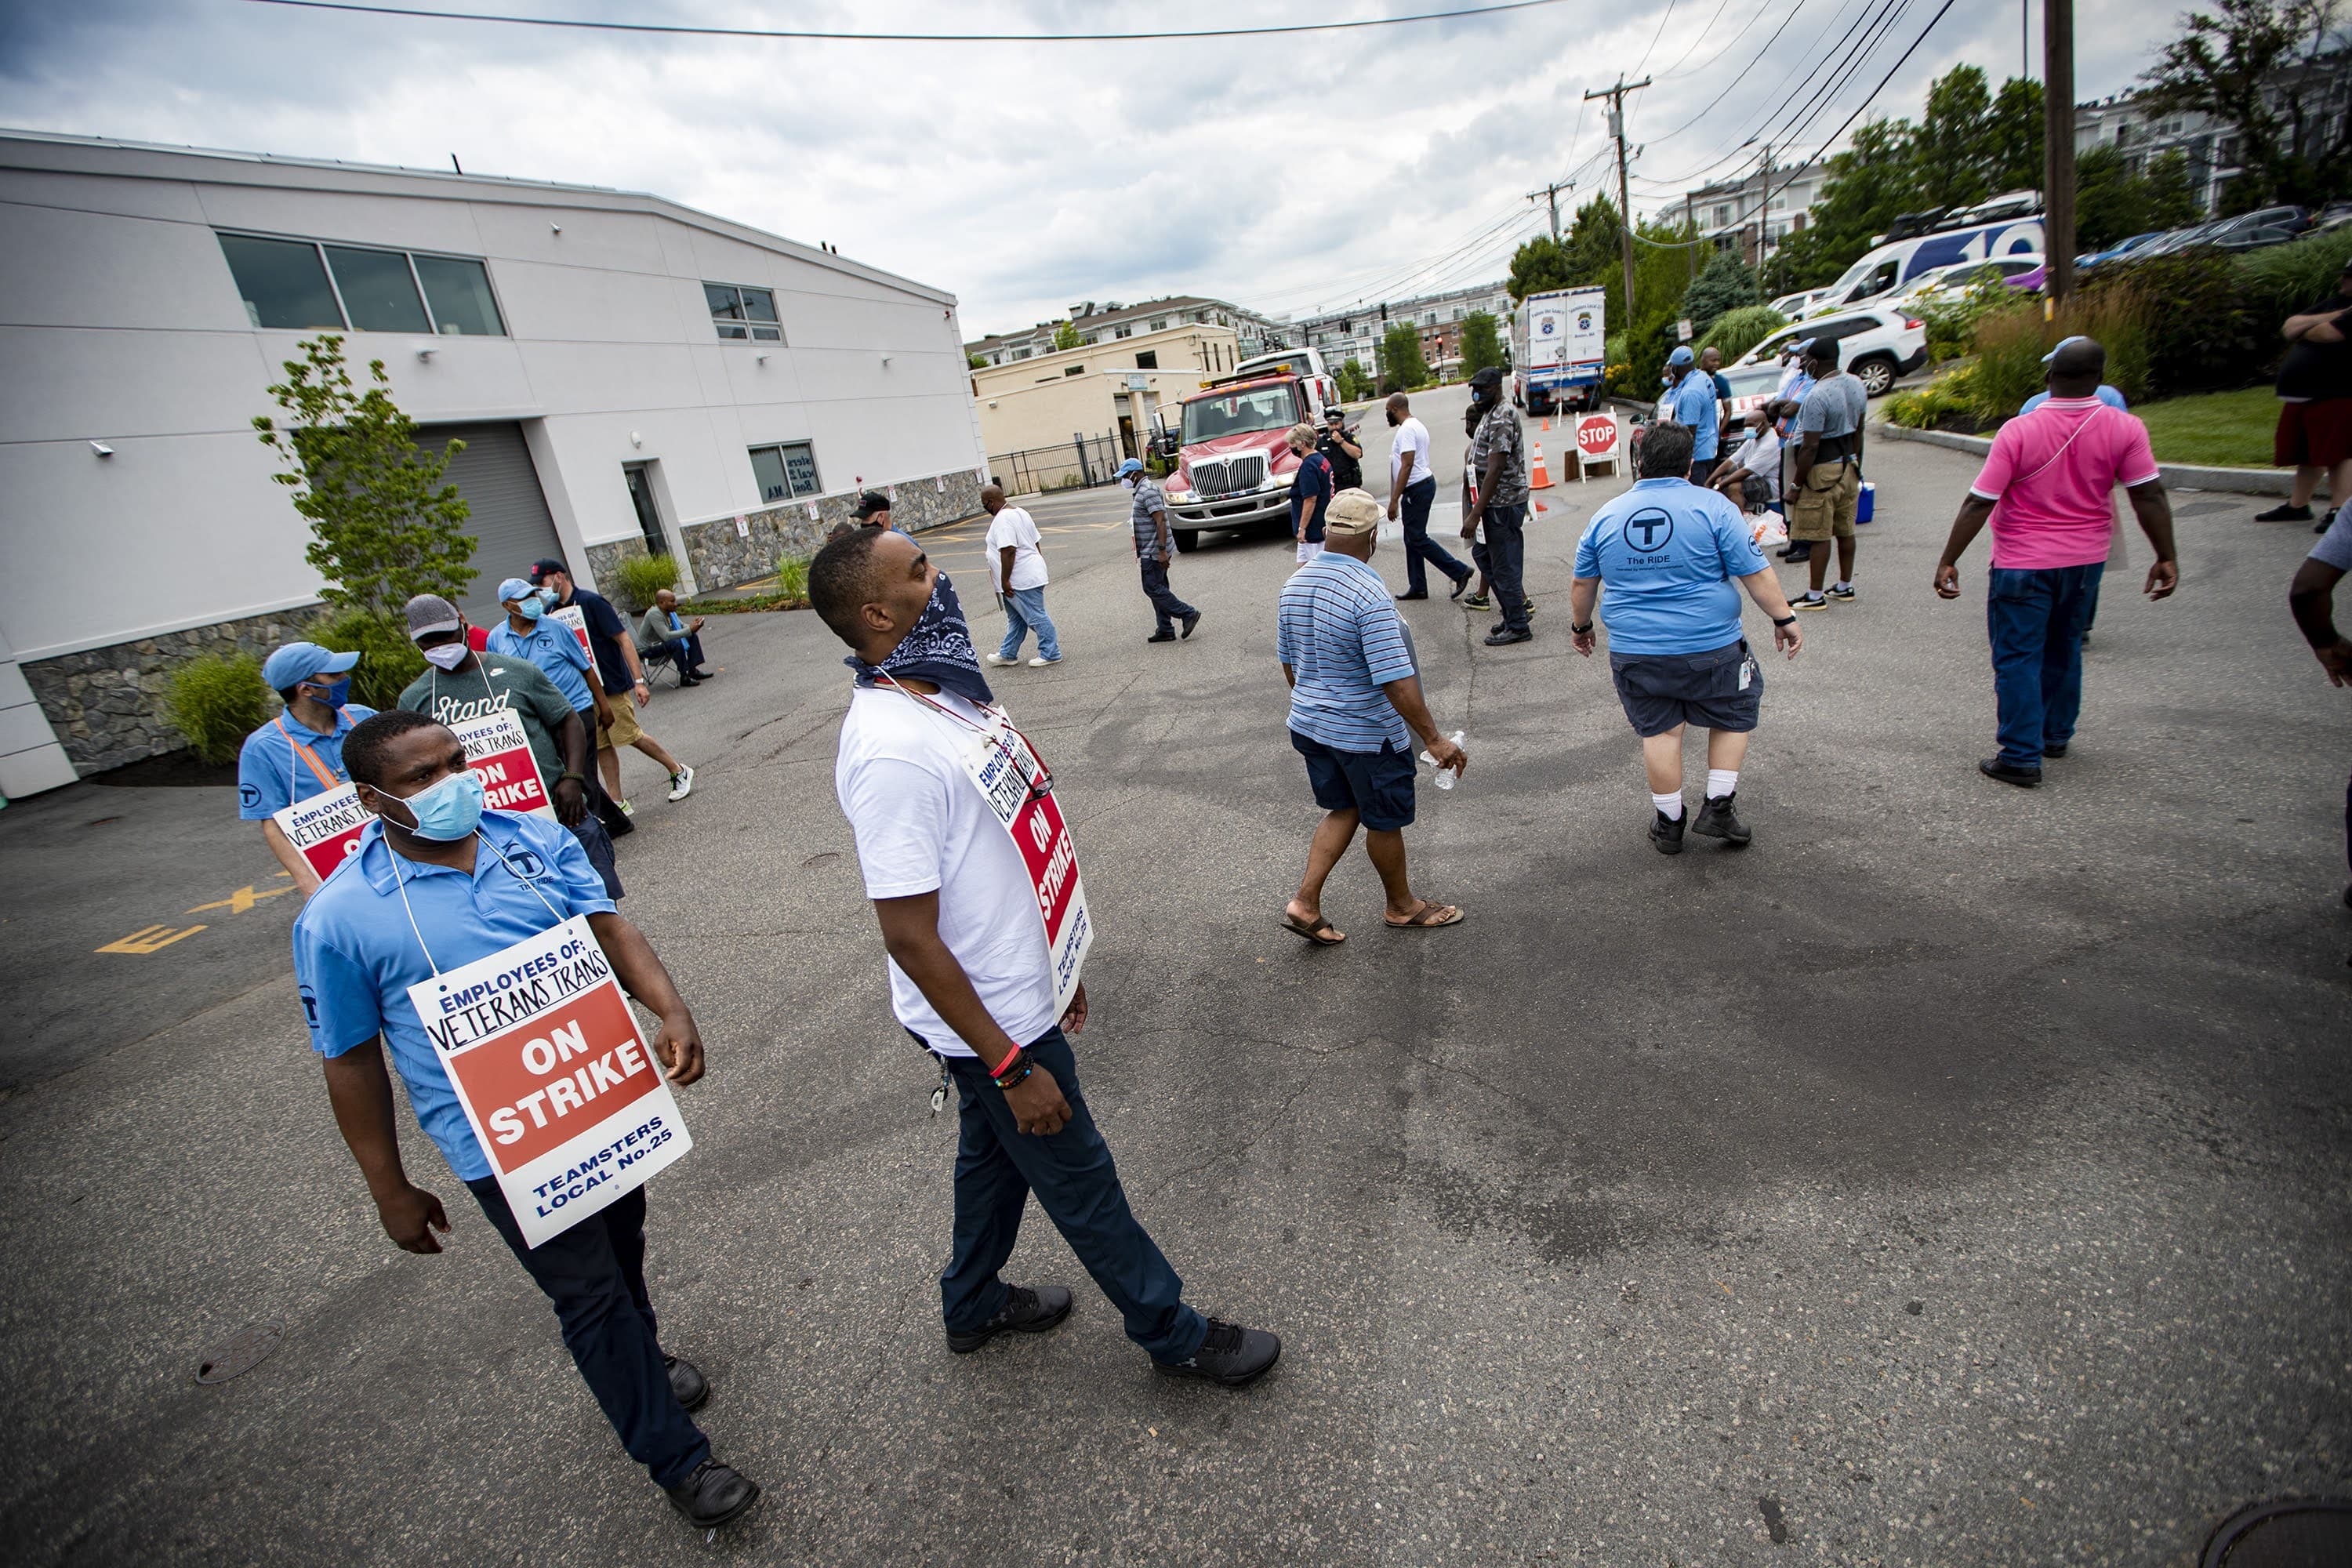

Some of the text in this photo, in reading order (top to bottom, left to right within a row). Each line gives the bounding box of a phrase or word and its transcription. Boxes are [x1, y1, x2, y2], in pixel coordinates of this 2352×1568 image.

[1579, 426, 1614, 445] STOP
[1632, 517, 1666, 545] T
[1627, 555, 1671, 565] The RIDE
[432, 688, 510, 725] Stand
[485, 730, 524, 753] TRANS
[495, 722, 514, 734] OF:
[292, 793, 359, 827] EMPLOYEES
[484, 779, 541, 811] RIKE
[286, 810, 358, 848] VETERANS
[1029, 803, 1052, 854] ON
[536, 876, 554, 886] RIDE
[1038, 827, 1073, 920] STRIKE
[1058, 906, 1083, 976] TEAMSTERS
[439, 939, 586, 1014] EMPLOYEES OF:
[1058, 953, 1076, 996] LOCAL
[427, 949, 609, 1051] VETERANS TRANS
[521, 1019, 590, 1076] ON
[488, 1037, 648, 1145] STRIKE
[532, 1116, 663, 1200] TEAMSTERS
[535, 1128, 673, 1218] LOCAL No.25
